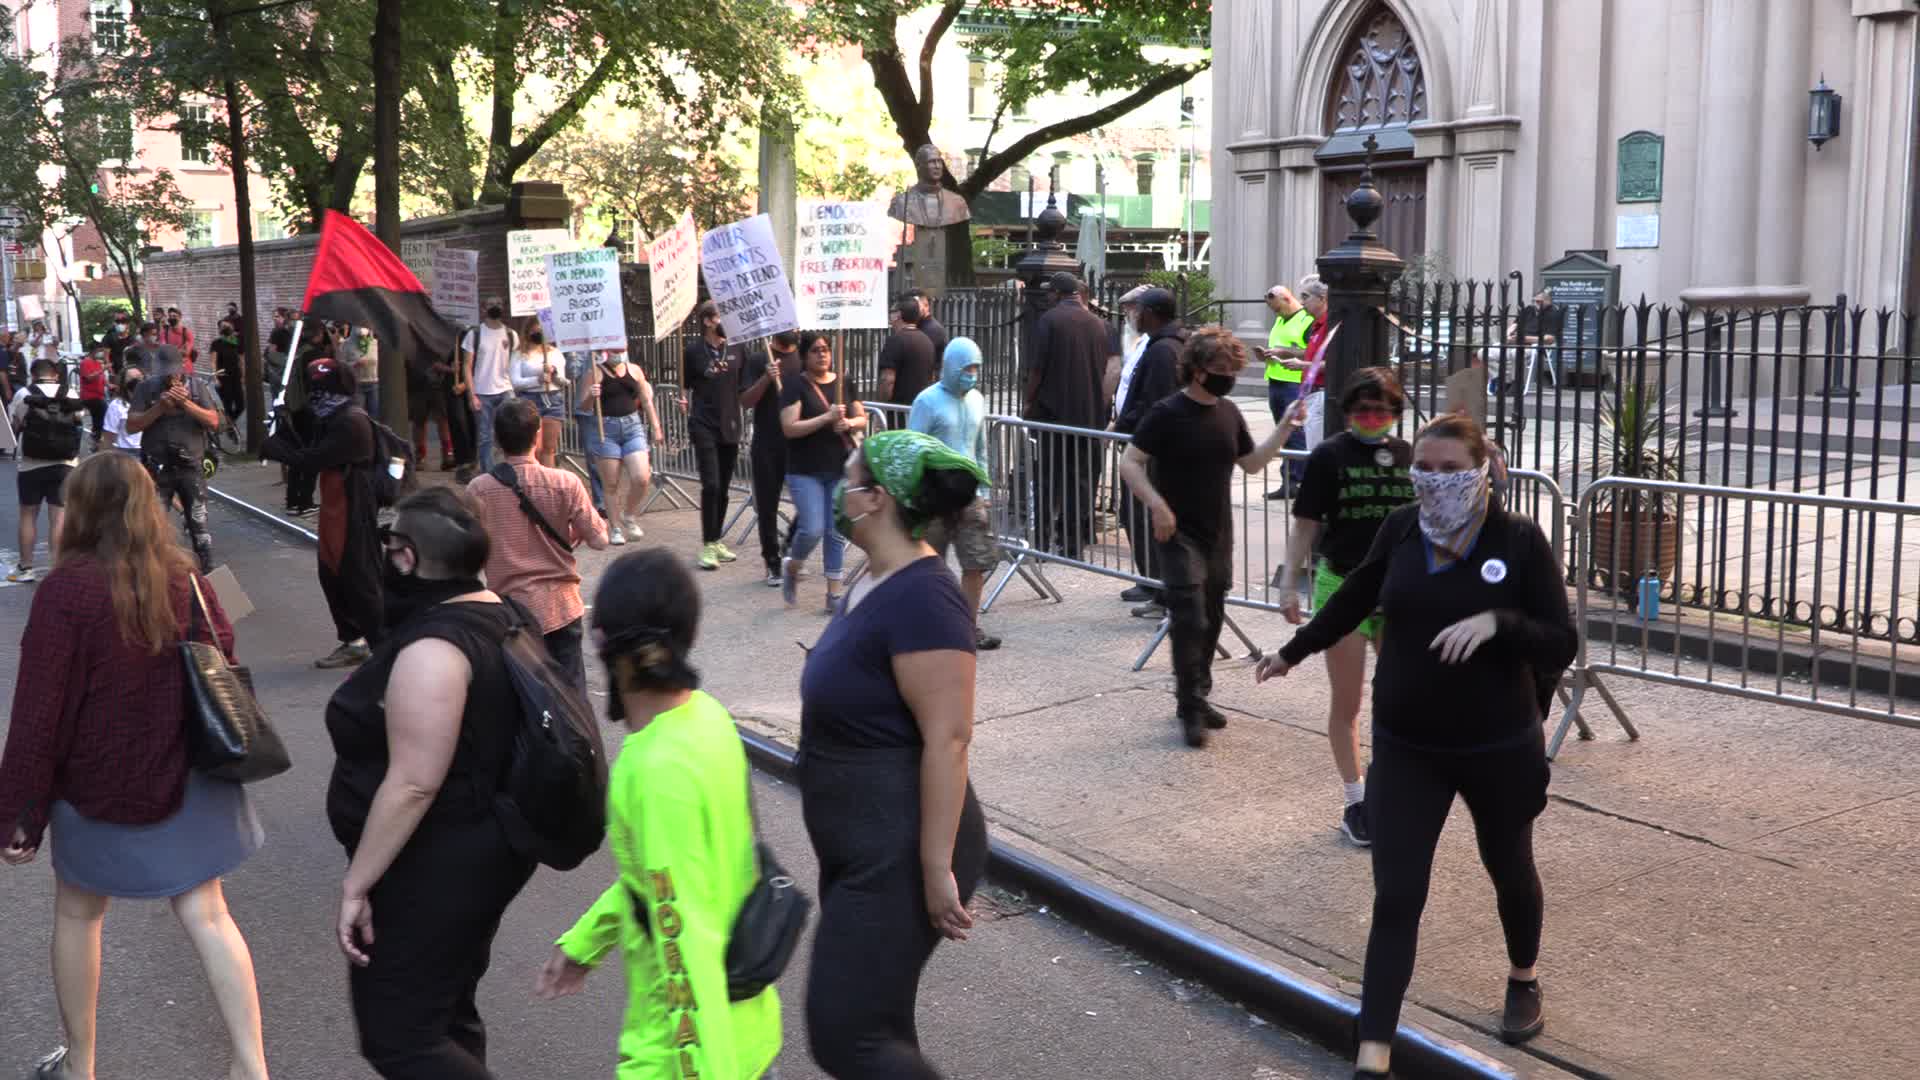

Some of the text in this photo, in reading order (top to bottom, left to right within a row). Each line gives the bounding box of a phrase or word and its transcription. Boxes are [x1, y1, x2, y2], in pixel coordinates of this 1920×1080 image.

[801, 223, 867, 238] NO FRIENDS
[820, 240, 863, 254] WOMEN
[553, 249, 618, 267] FREE ABORTION
[704, 246, 767, 274] STUDENTS
[800, 257, 884, 273] FREE ABORTION
[555, 271, 567, 281] ON
[571, 268, 606, 280] DEMAND
[735, 264, 781, 289] DEFEND
[802, 283, 816, 296] ON
[569, 296, 601, 310] BIGOTS
[717, 289, 764, 315] ABORTION
[560, 312, 576, 323] GET
[581, 310, 604, 322] OUT!
[1338, 484, 1376, 499] AND
